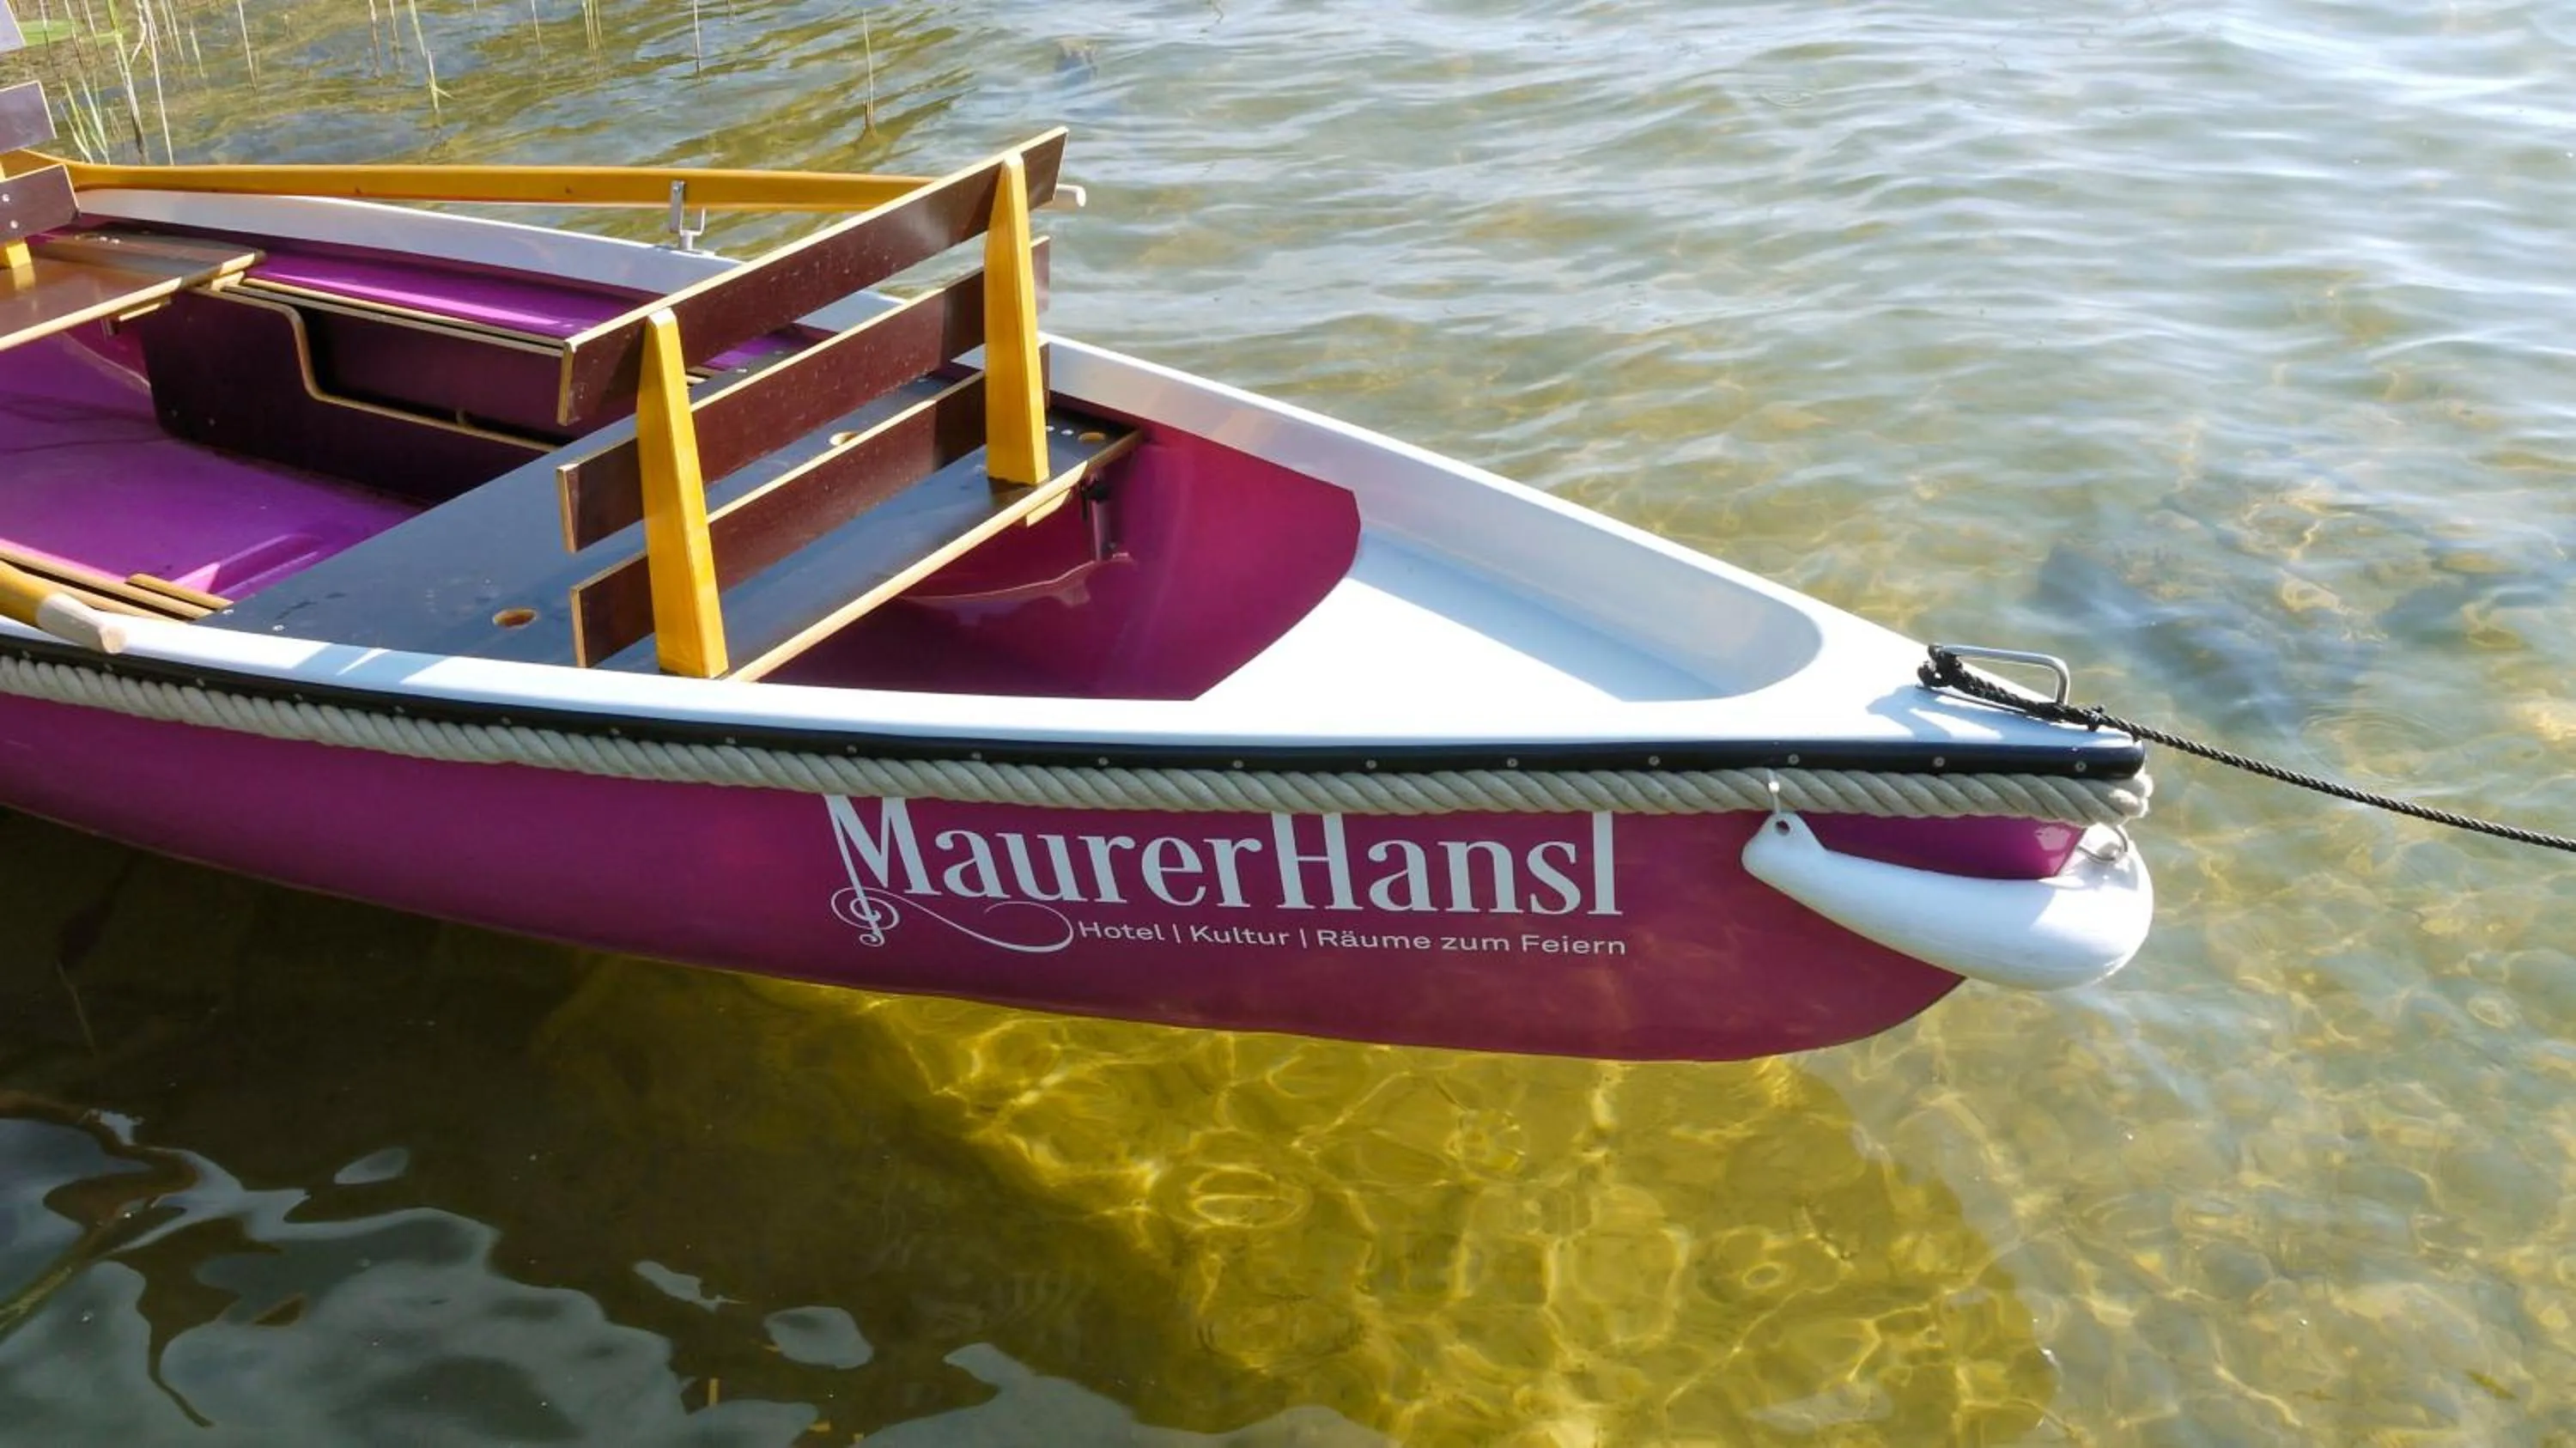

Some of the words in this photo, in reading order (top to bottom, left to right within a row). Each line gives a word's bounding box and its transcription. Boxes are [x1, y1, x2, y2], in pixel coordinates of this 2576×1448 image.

[823, 794, 1624, 917] MaurerHansl
[1078, 919, 1165, 942] Hotel
[1190, 924, 1290, 946] Kultur
[1317, 928, 1431, 951] Räume
[1440, 934, 1511, 952] zum
[1522, 934, 1626, 956] Feiern
